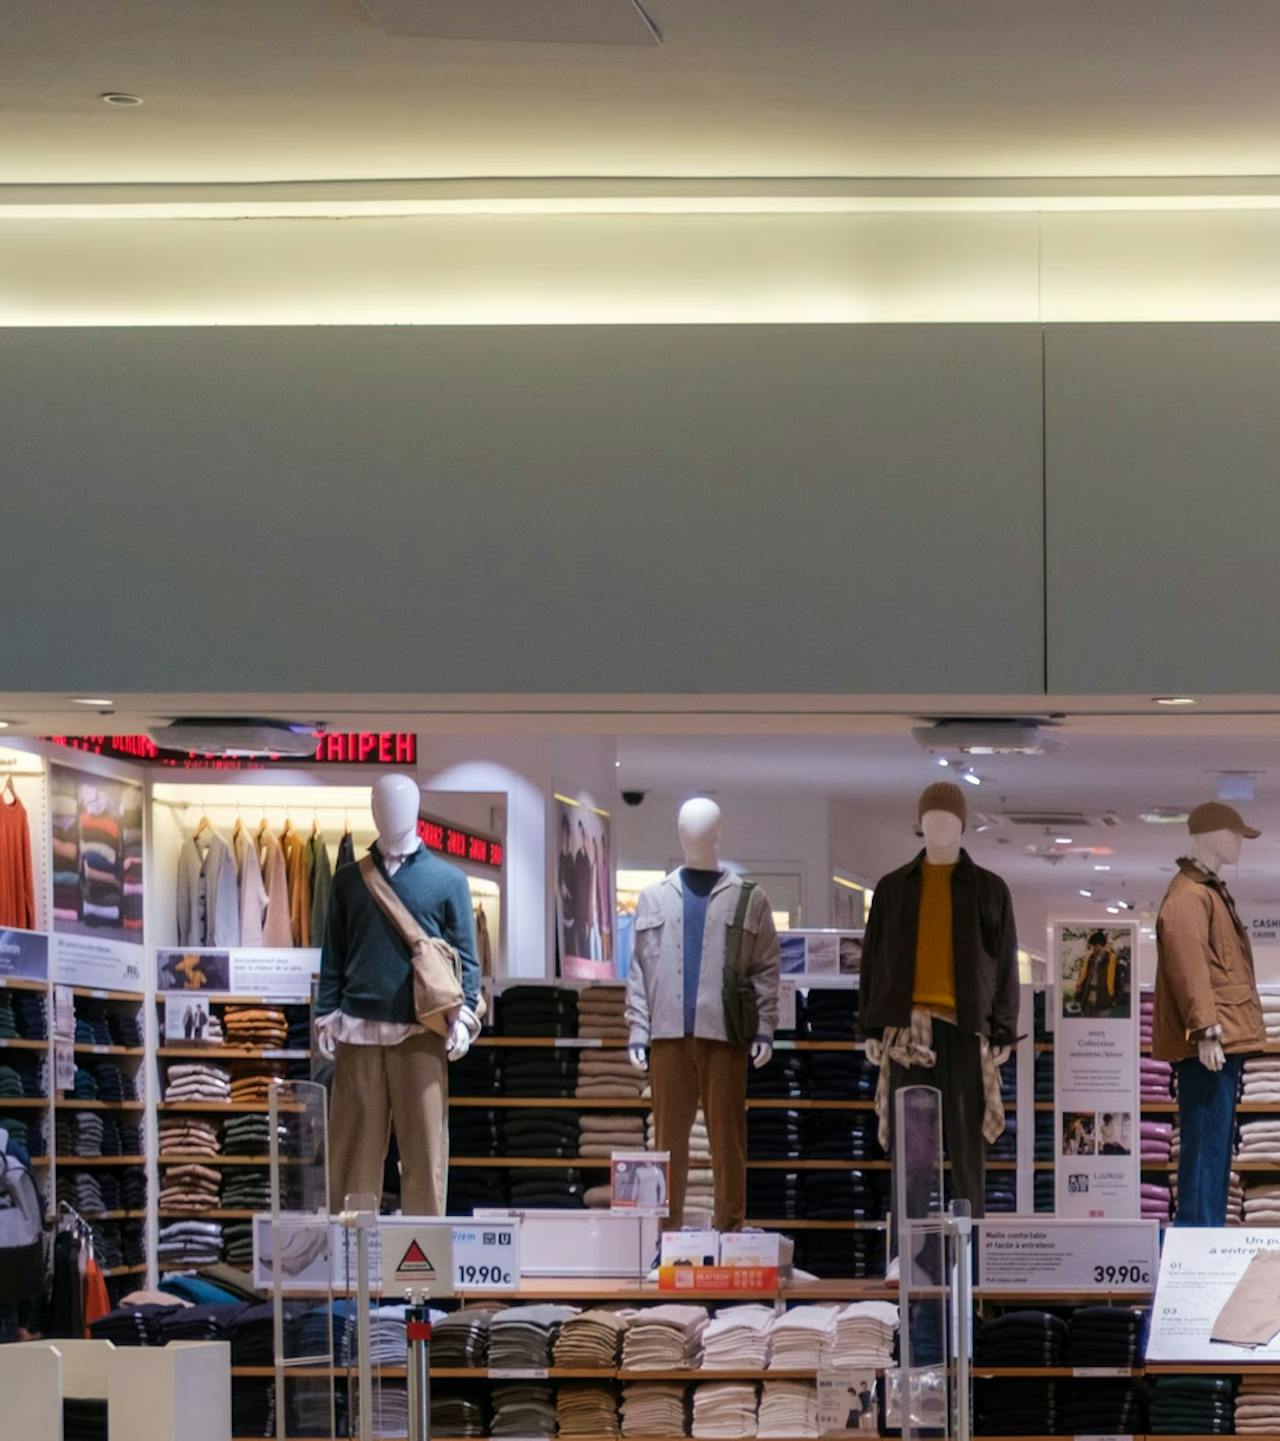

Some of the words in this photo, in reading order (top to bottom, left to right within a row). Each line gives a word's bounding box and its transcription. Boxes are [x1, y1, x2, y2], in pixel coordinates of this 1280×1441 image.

[1007, 1231, 1047, 1239] confortable
[994, 1241, 1014, 1249] facile
[1245, 1236, 1263, 1245] Un
[1209, 1246, 1217, 1255] à
[459, 1265, 511, 1284] 19,90€
[1094, 1266, 1149, 1285] 39,90€
